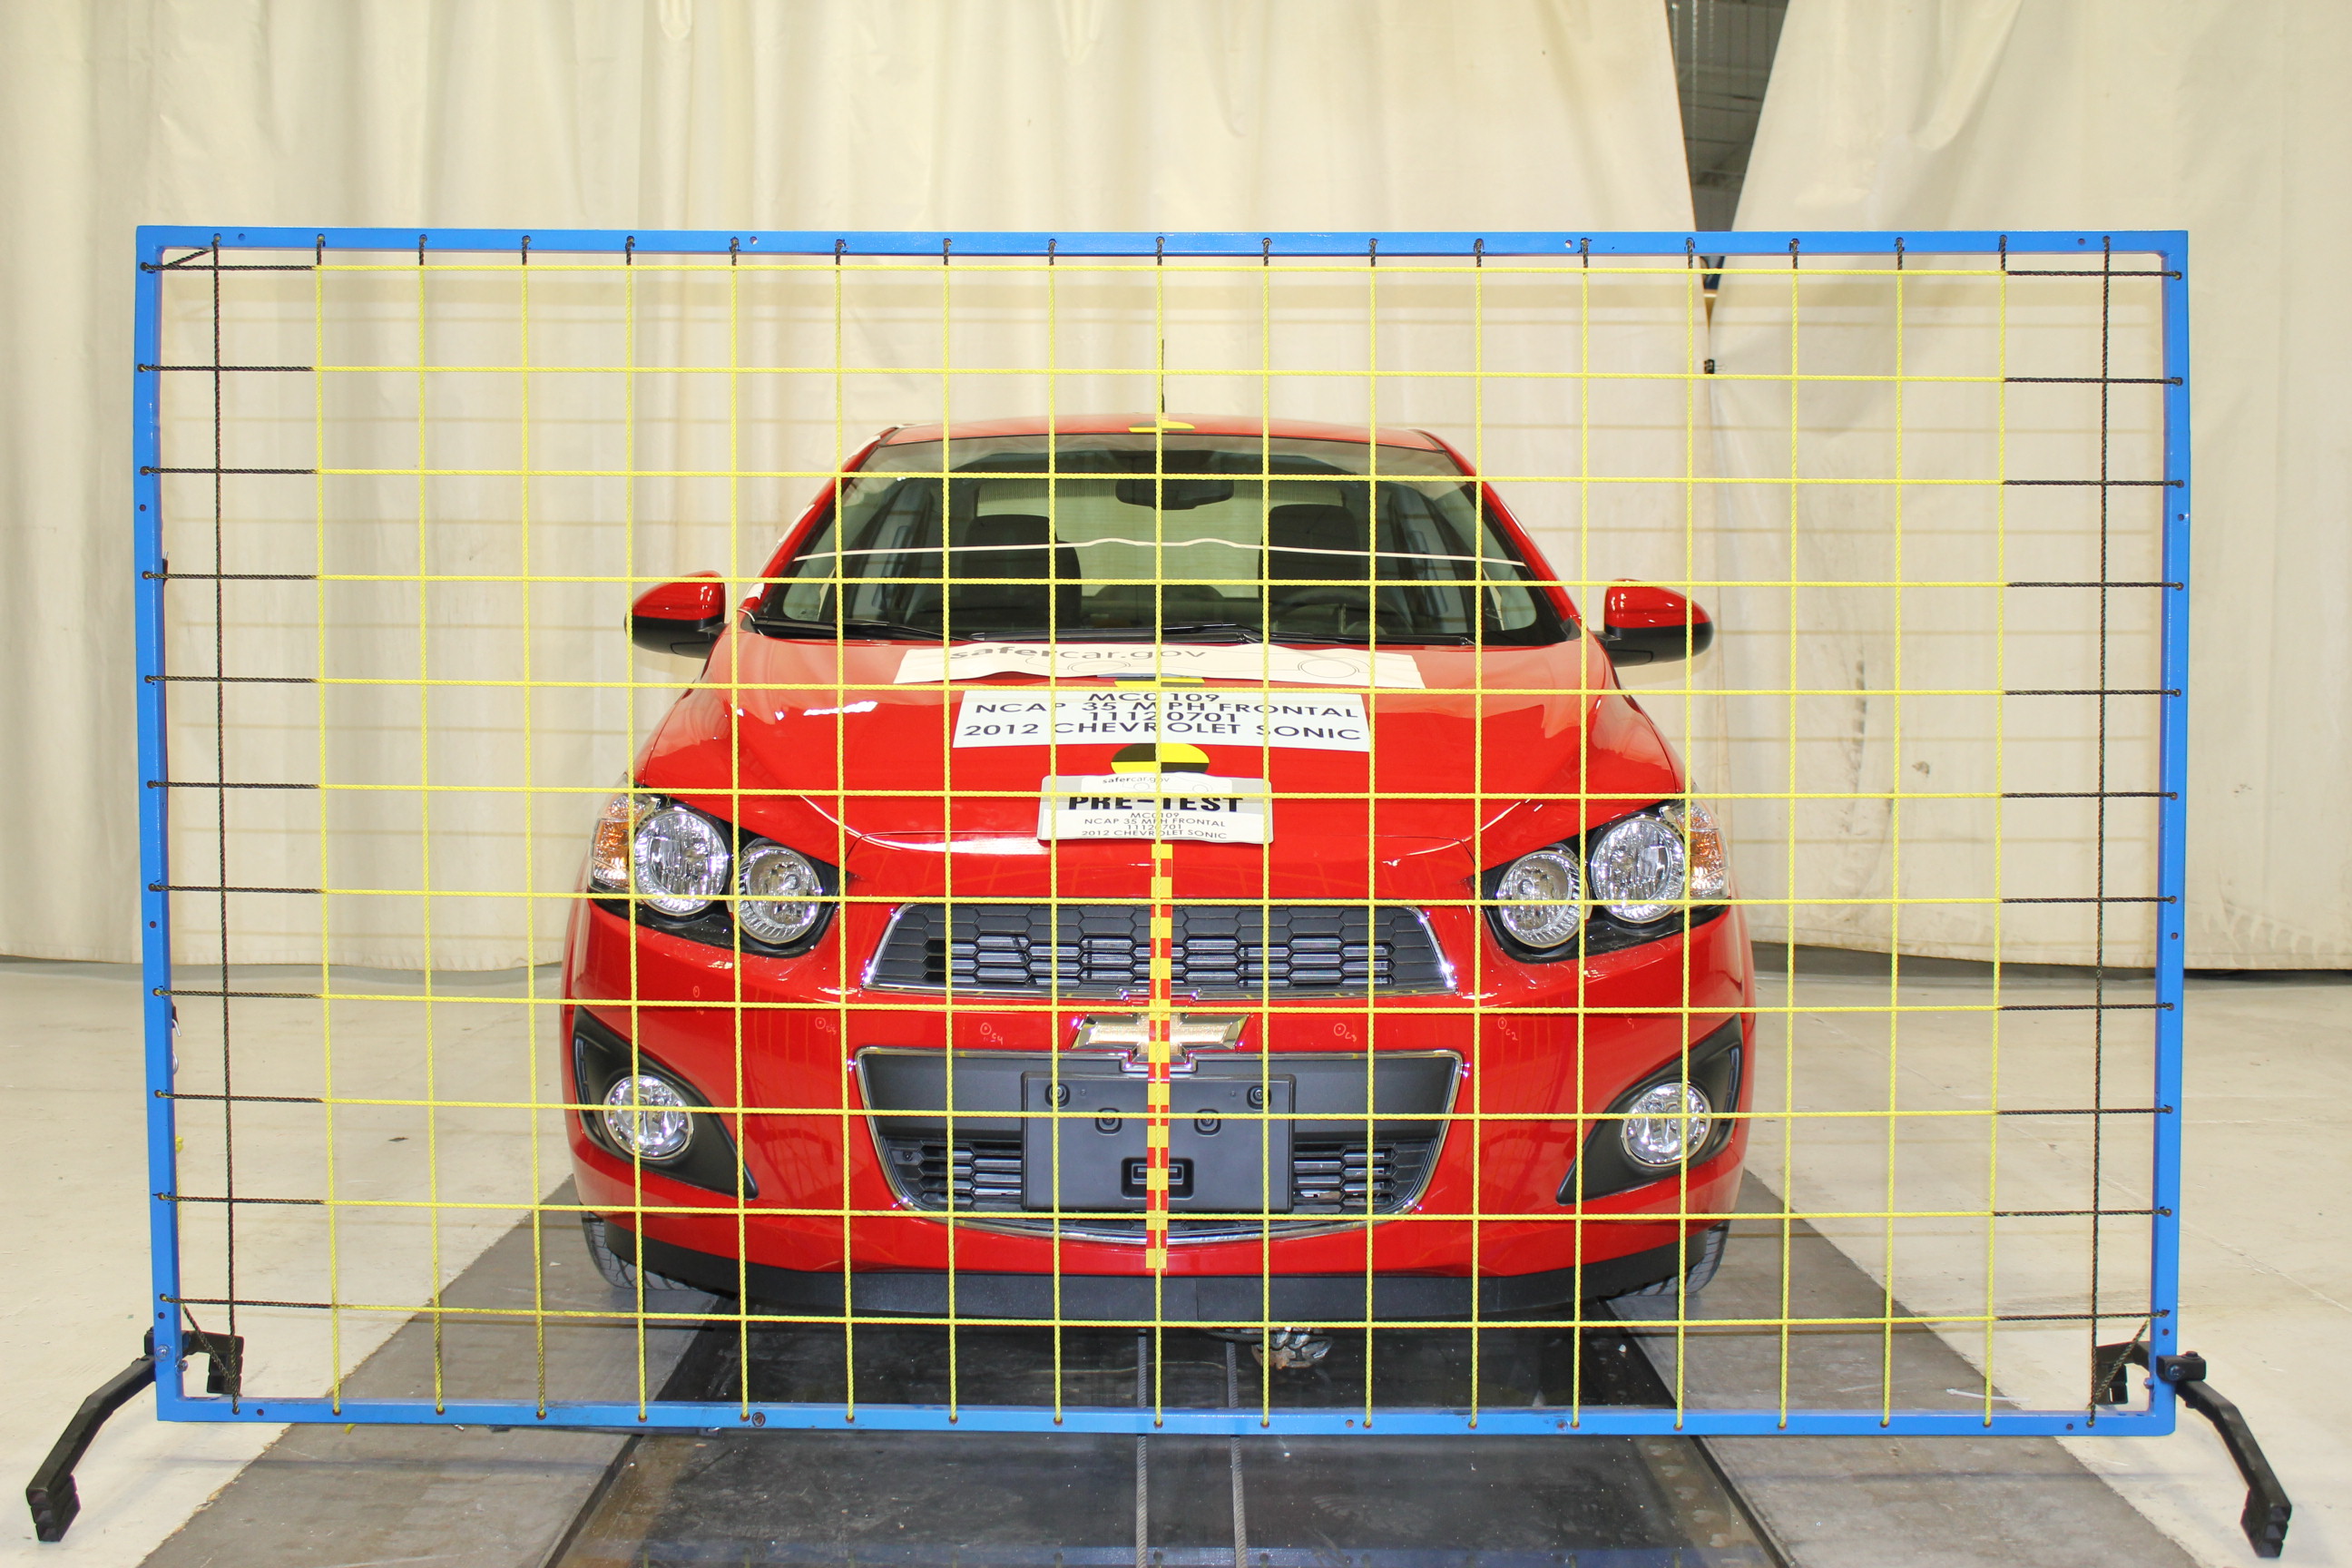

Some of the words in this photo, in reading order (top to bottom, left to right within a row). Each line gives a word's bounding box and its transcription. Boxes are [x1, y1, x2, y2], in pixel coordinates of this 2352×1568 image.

[950, 645, 1206, 660] safercar.gov
[1082, 701, 1117, 711] 35
[1132, 701, 1205, 711] MPH
[1220, 702, 1358, 718] FRONTAL
[1089, 711, 1236, 722] 11120701
[964, 724, 1039, 736] 2012
[1054, 721, 1240, 734] CHEVROLET
[1256, 723, 1361, 740] SONIC
[1172, 818, 1226, 827] FRONTAL
[1188, 829, 1227, 839] SONIC
